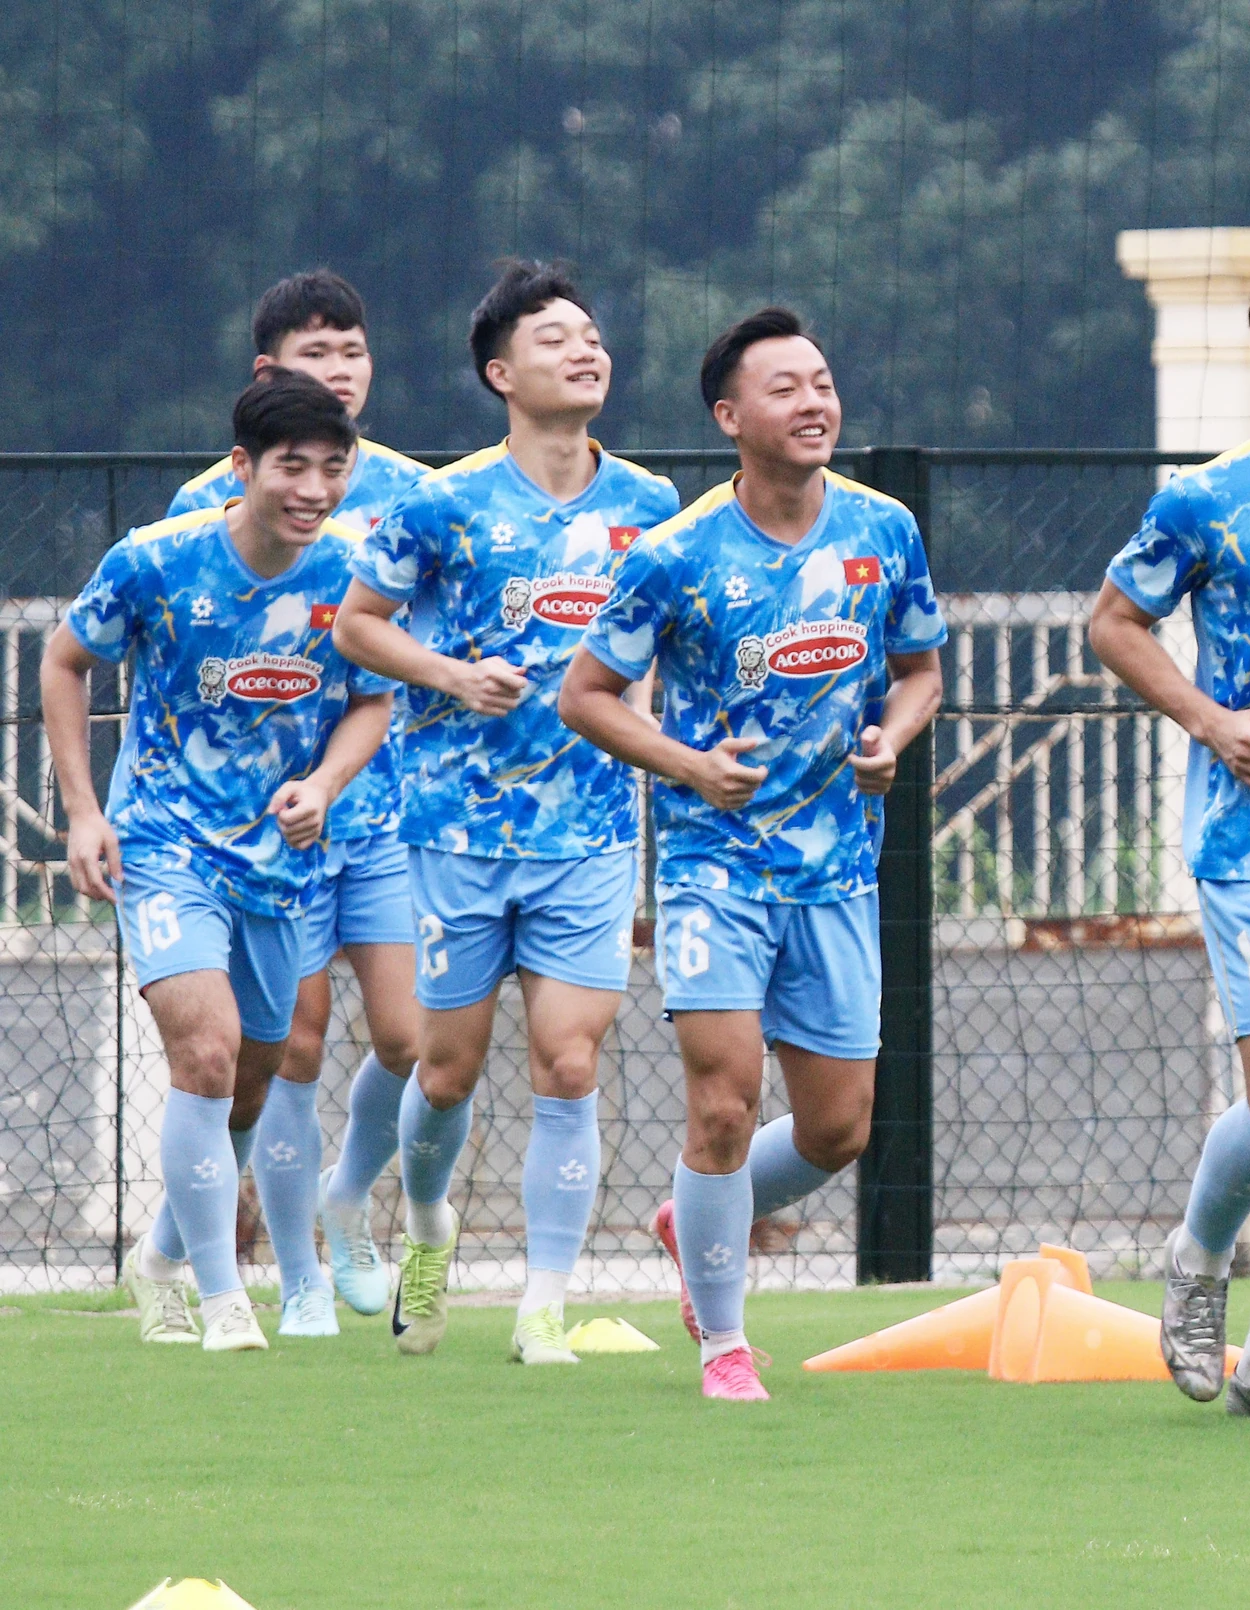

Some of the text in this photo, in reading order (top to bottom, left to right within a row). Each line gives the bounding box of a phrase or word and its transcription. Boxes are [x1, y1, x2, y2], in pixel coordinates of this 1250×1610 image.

[533, 574, 613, 591] Cook happin
[766, 620, 865, 647] Cook happiness
[228, 655, 321, 673] Cook happiness
[137, 890, 182, 957] 15
[418, 913, 449, 979] 2
[679, 908, 712, 979] 6
